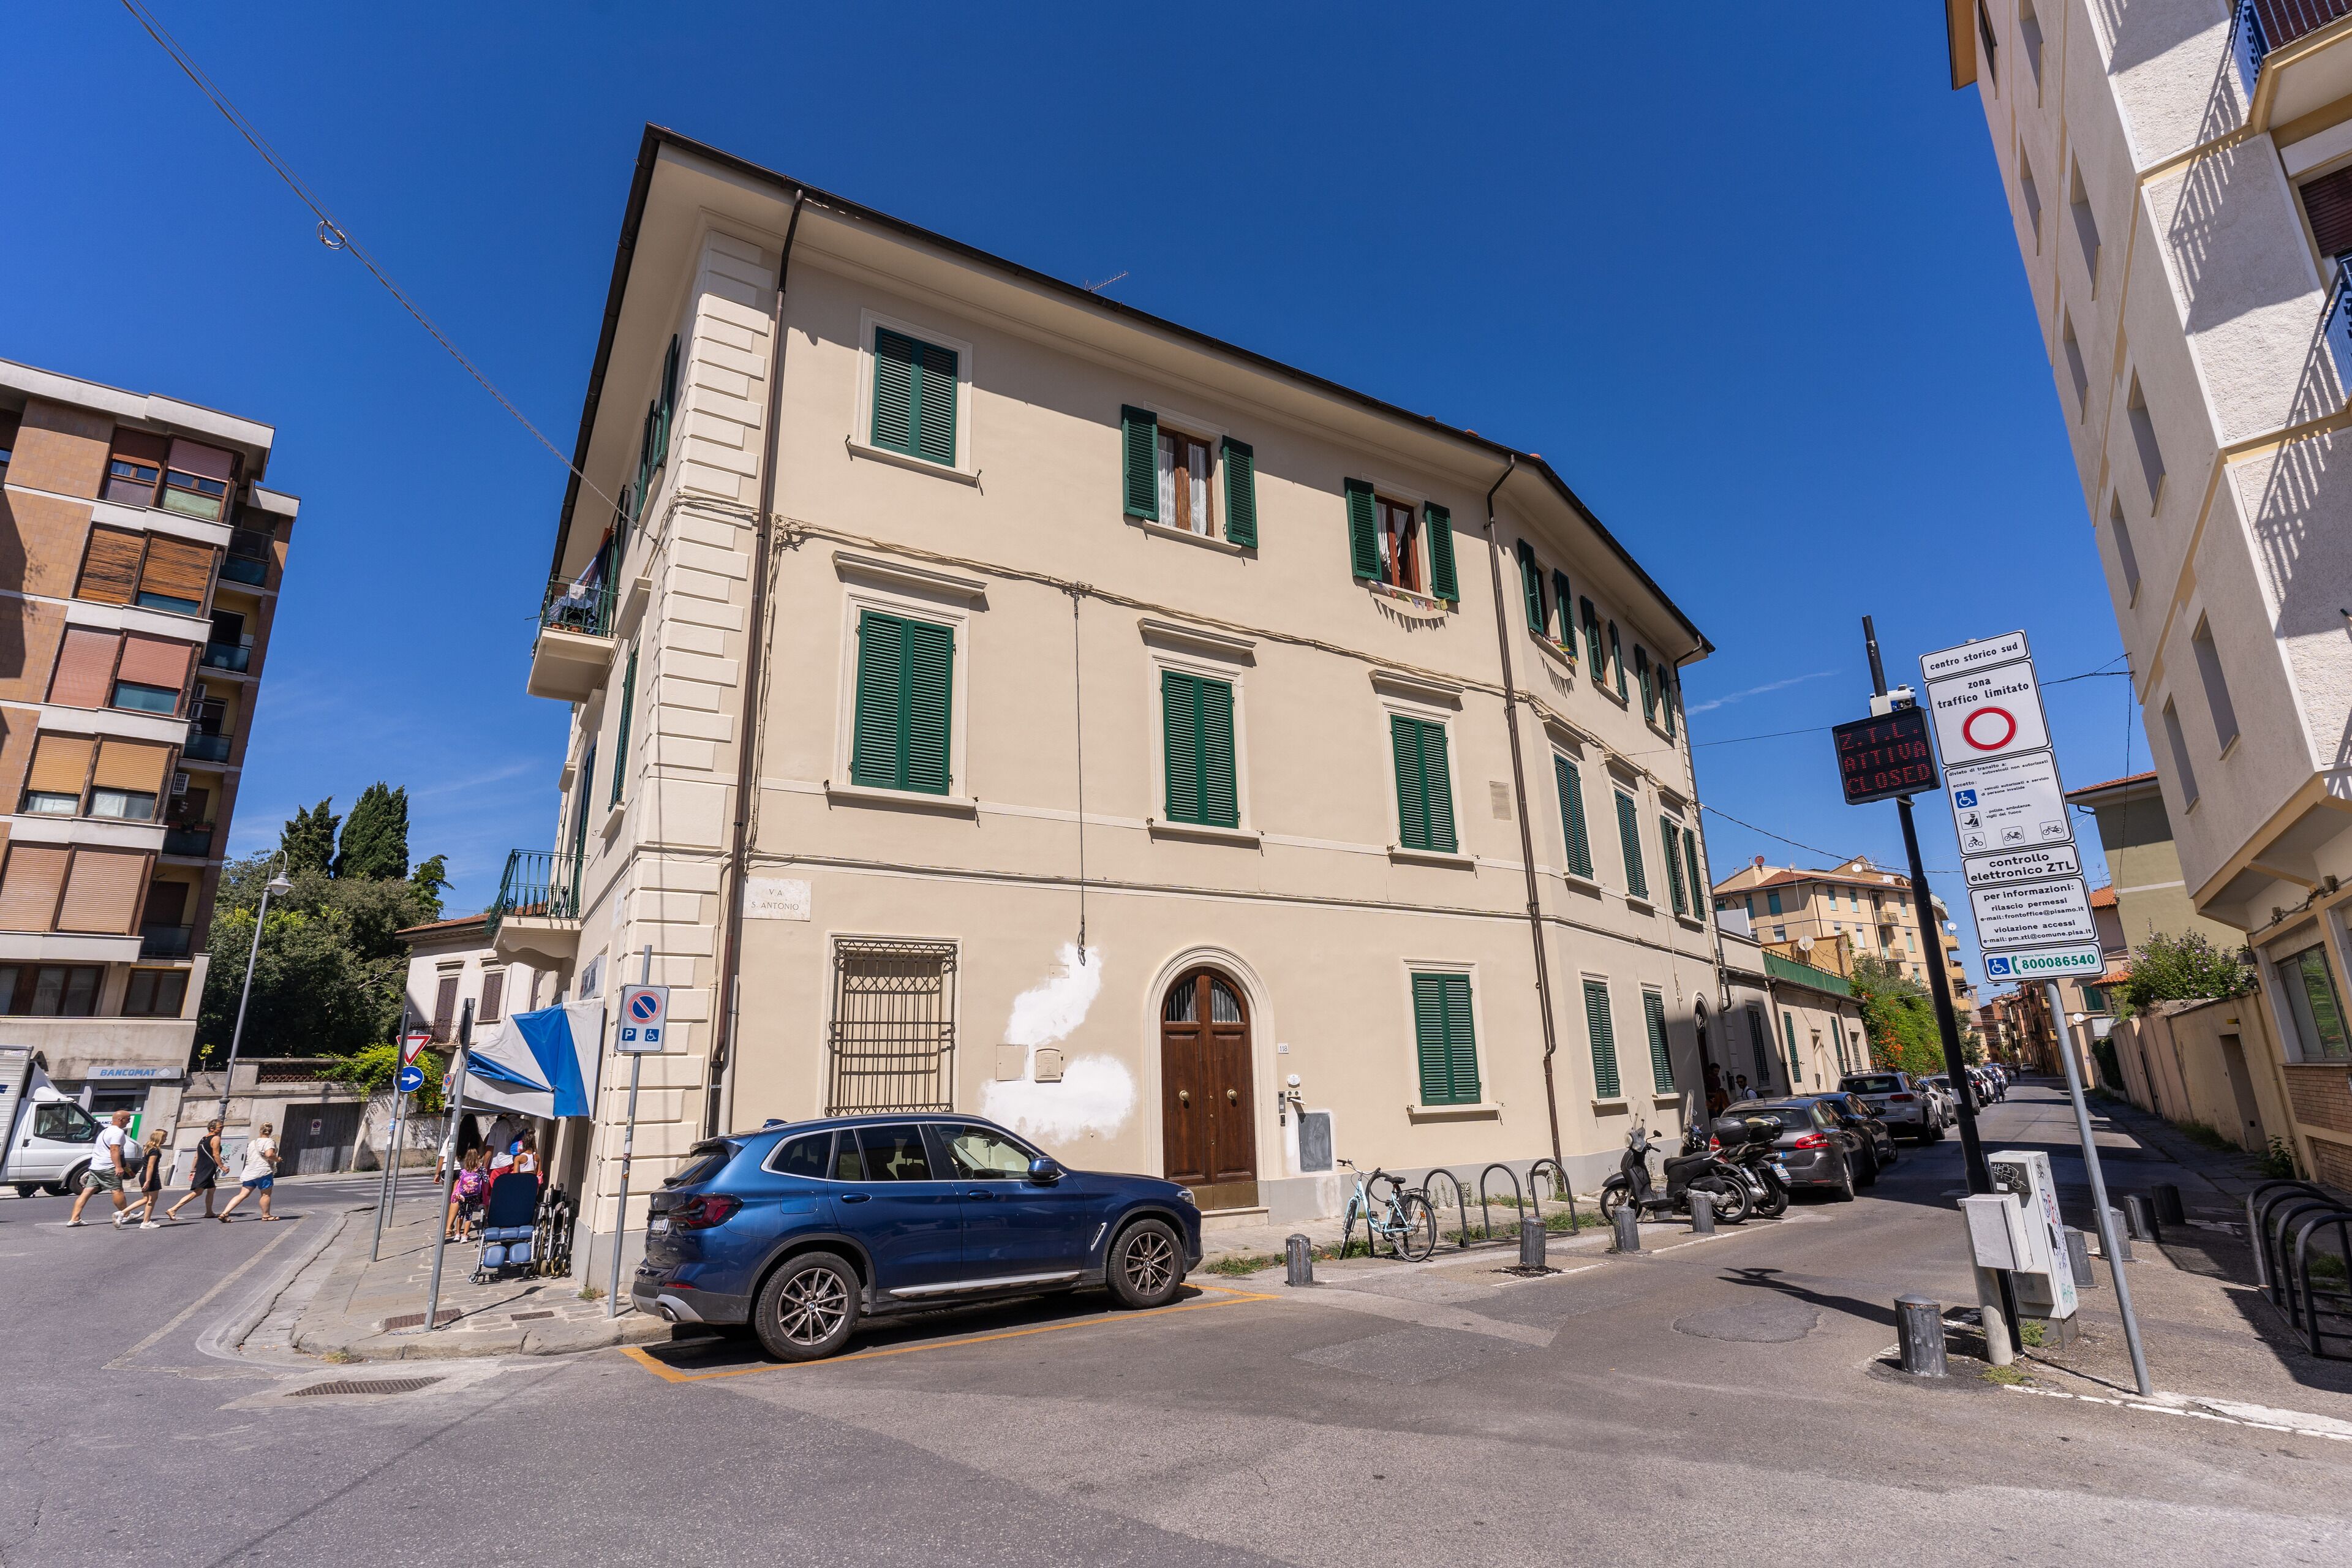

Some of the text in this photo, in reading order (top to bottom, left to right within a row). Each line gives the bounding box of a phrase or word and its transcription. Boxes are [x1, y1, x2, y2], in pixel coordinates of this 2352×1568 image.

[1929, 643, 2018, 671] centro storico sud
[1967, 678, 1991, 689] zona
[1937, 683, 2029, 709] traffico limitato
[1844, 741, 1927, 772] ATTIVA
[1982, 767, 2008, 775] autoveicoli
[2022, 760, 2048, 768] autorizzati
[1847, 763, 1932, 794] CLOSED
[1989, 853, 2049, 868] controllo
[1970, 861, 2075, 881] elettronico ZTL
[1983, 884, 2075, 902] per informazioni:
[761, 902, 799, 911] ANTONIO
[1991, 897, 2068, 911] rilascio permessi
[1994, 919, 2076, 933] violazione accessi
[2022, 954, 2095, 970] 800086540
[100, 1068, 157, 1077] BANCOMAT
